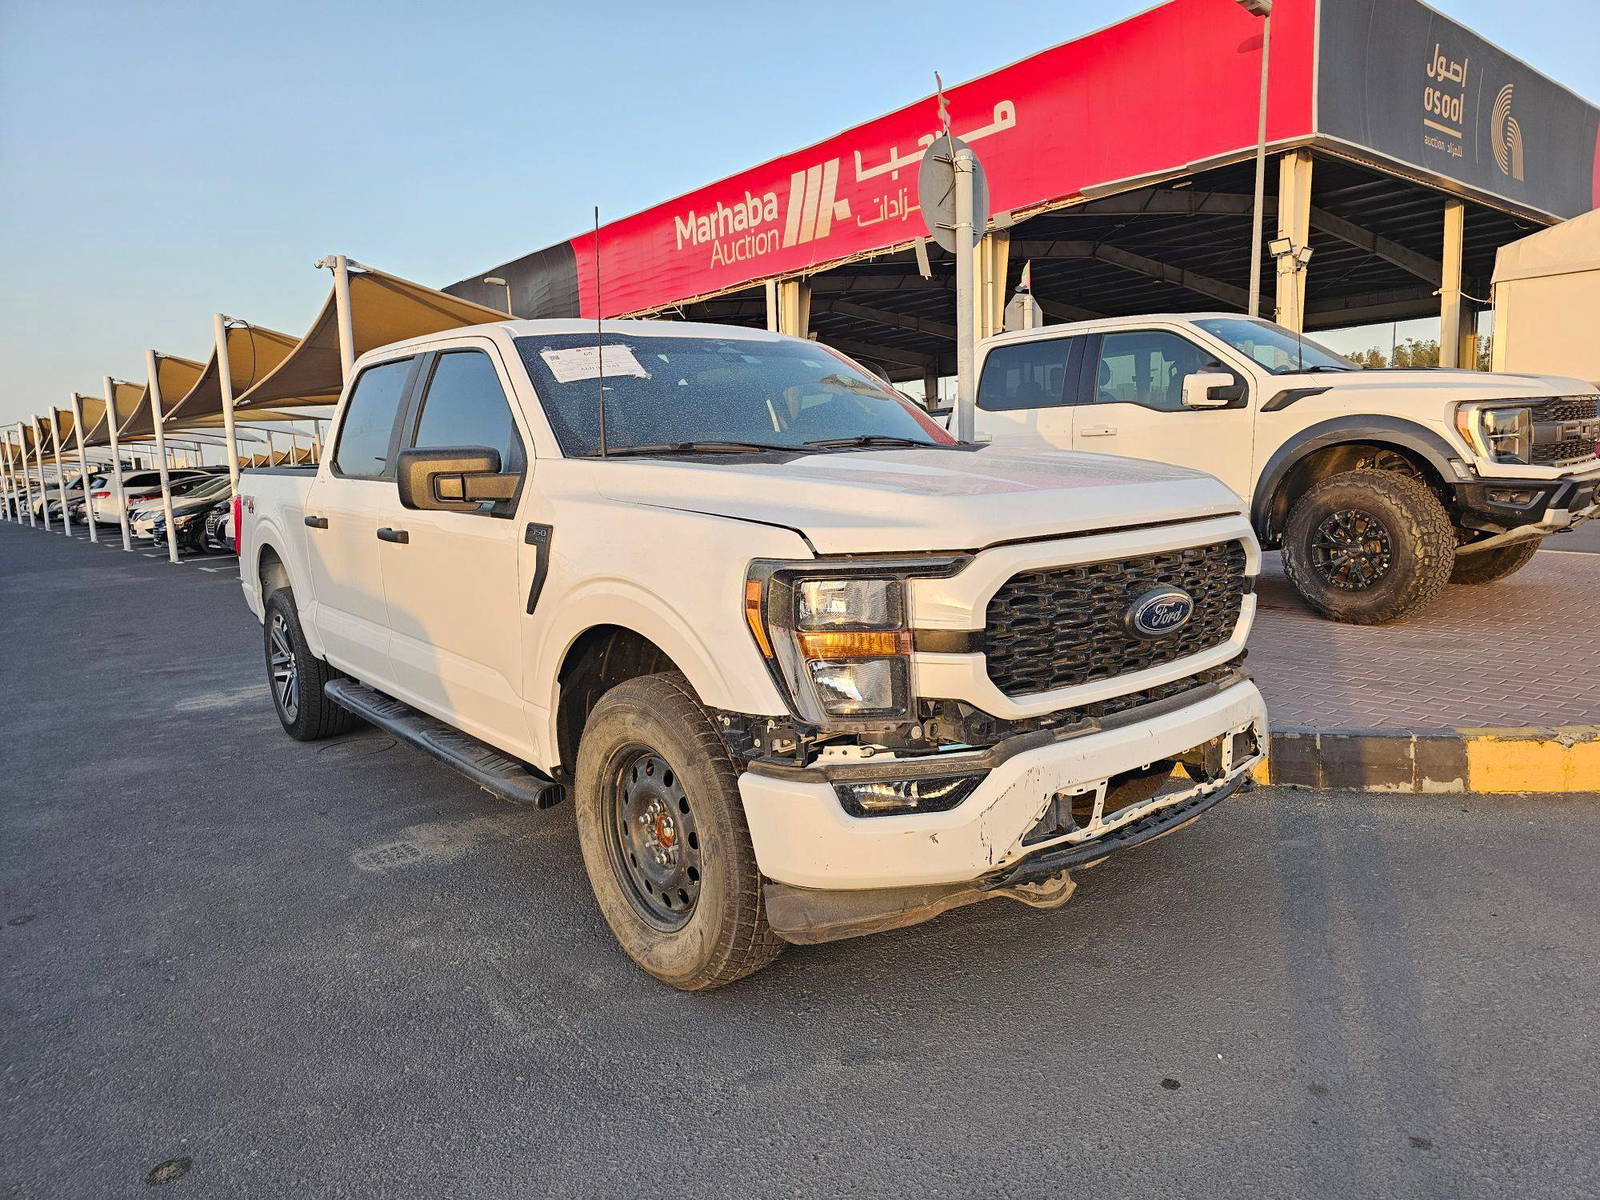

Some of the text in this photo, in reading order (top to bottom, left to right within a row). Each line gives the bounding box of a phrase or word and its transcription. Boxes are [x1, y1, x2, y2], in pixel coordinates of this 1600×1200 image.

[1424, 86, 1464, 125] osool
[853, 100, 1016, 183] محبا
[1424, 135, 1445, 151] auction
[674, 190, 779, 251] Marhaba
[857, 187, 920, 227] زادات
[709, 228, 780, 270] Auction
[1151, 602, 1183, 627] Ford
